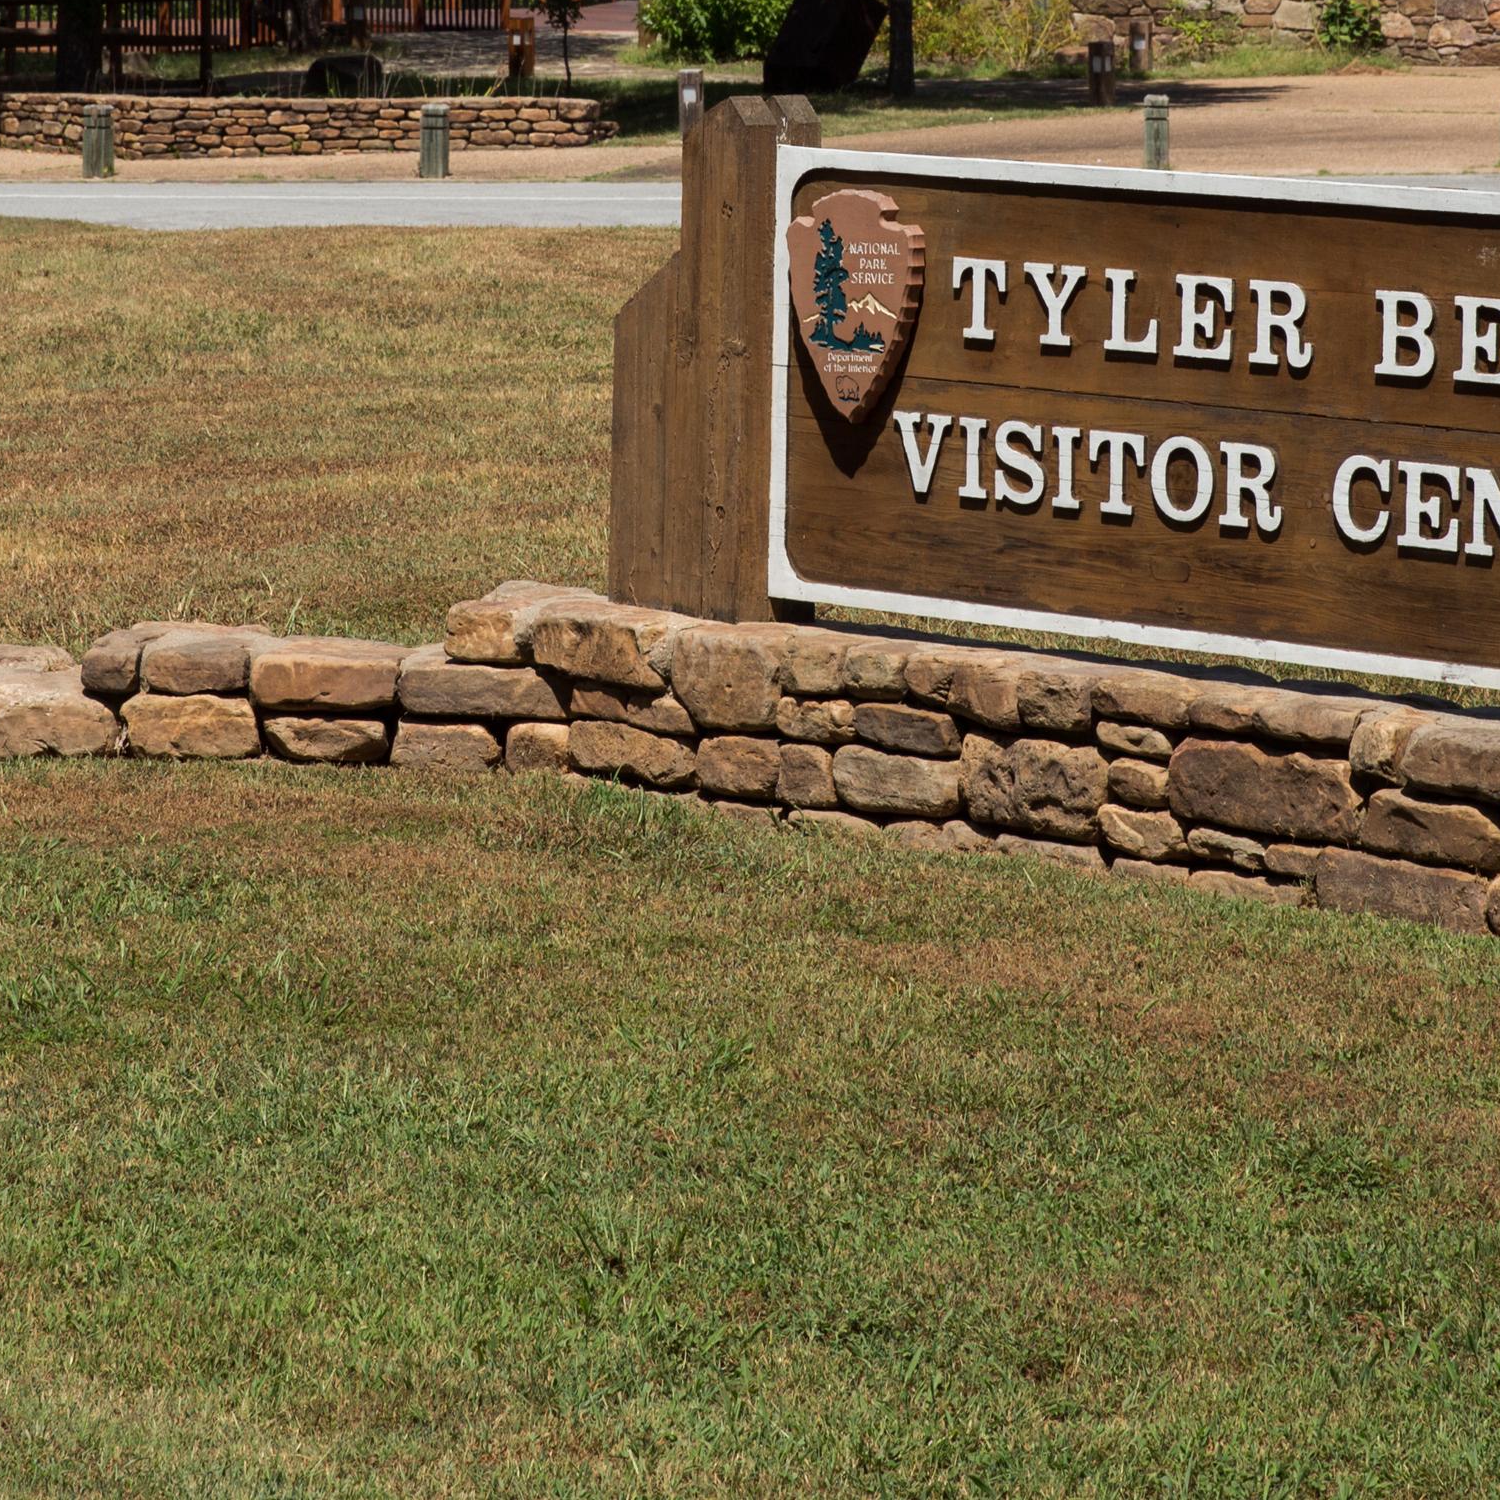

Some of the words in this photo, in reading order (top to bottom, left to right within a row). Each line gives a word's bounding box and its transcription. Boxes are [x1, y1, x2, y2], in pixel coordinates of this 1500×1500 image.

[849, 241, 901, 255] NATIONAL
[859, 257, 887, 270] PARK
[850, 271, 895, 285] SERVICE
[953, 256, 1313, 368] TYLER
[827, 352, 873, 364] Department
[823, 363, 832, 373] of
[833, 363, 846, 372] the
[893, 410, 1283, 532] VISITOR
